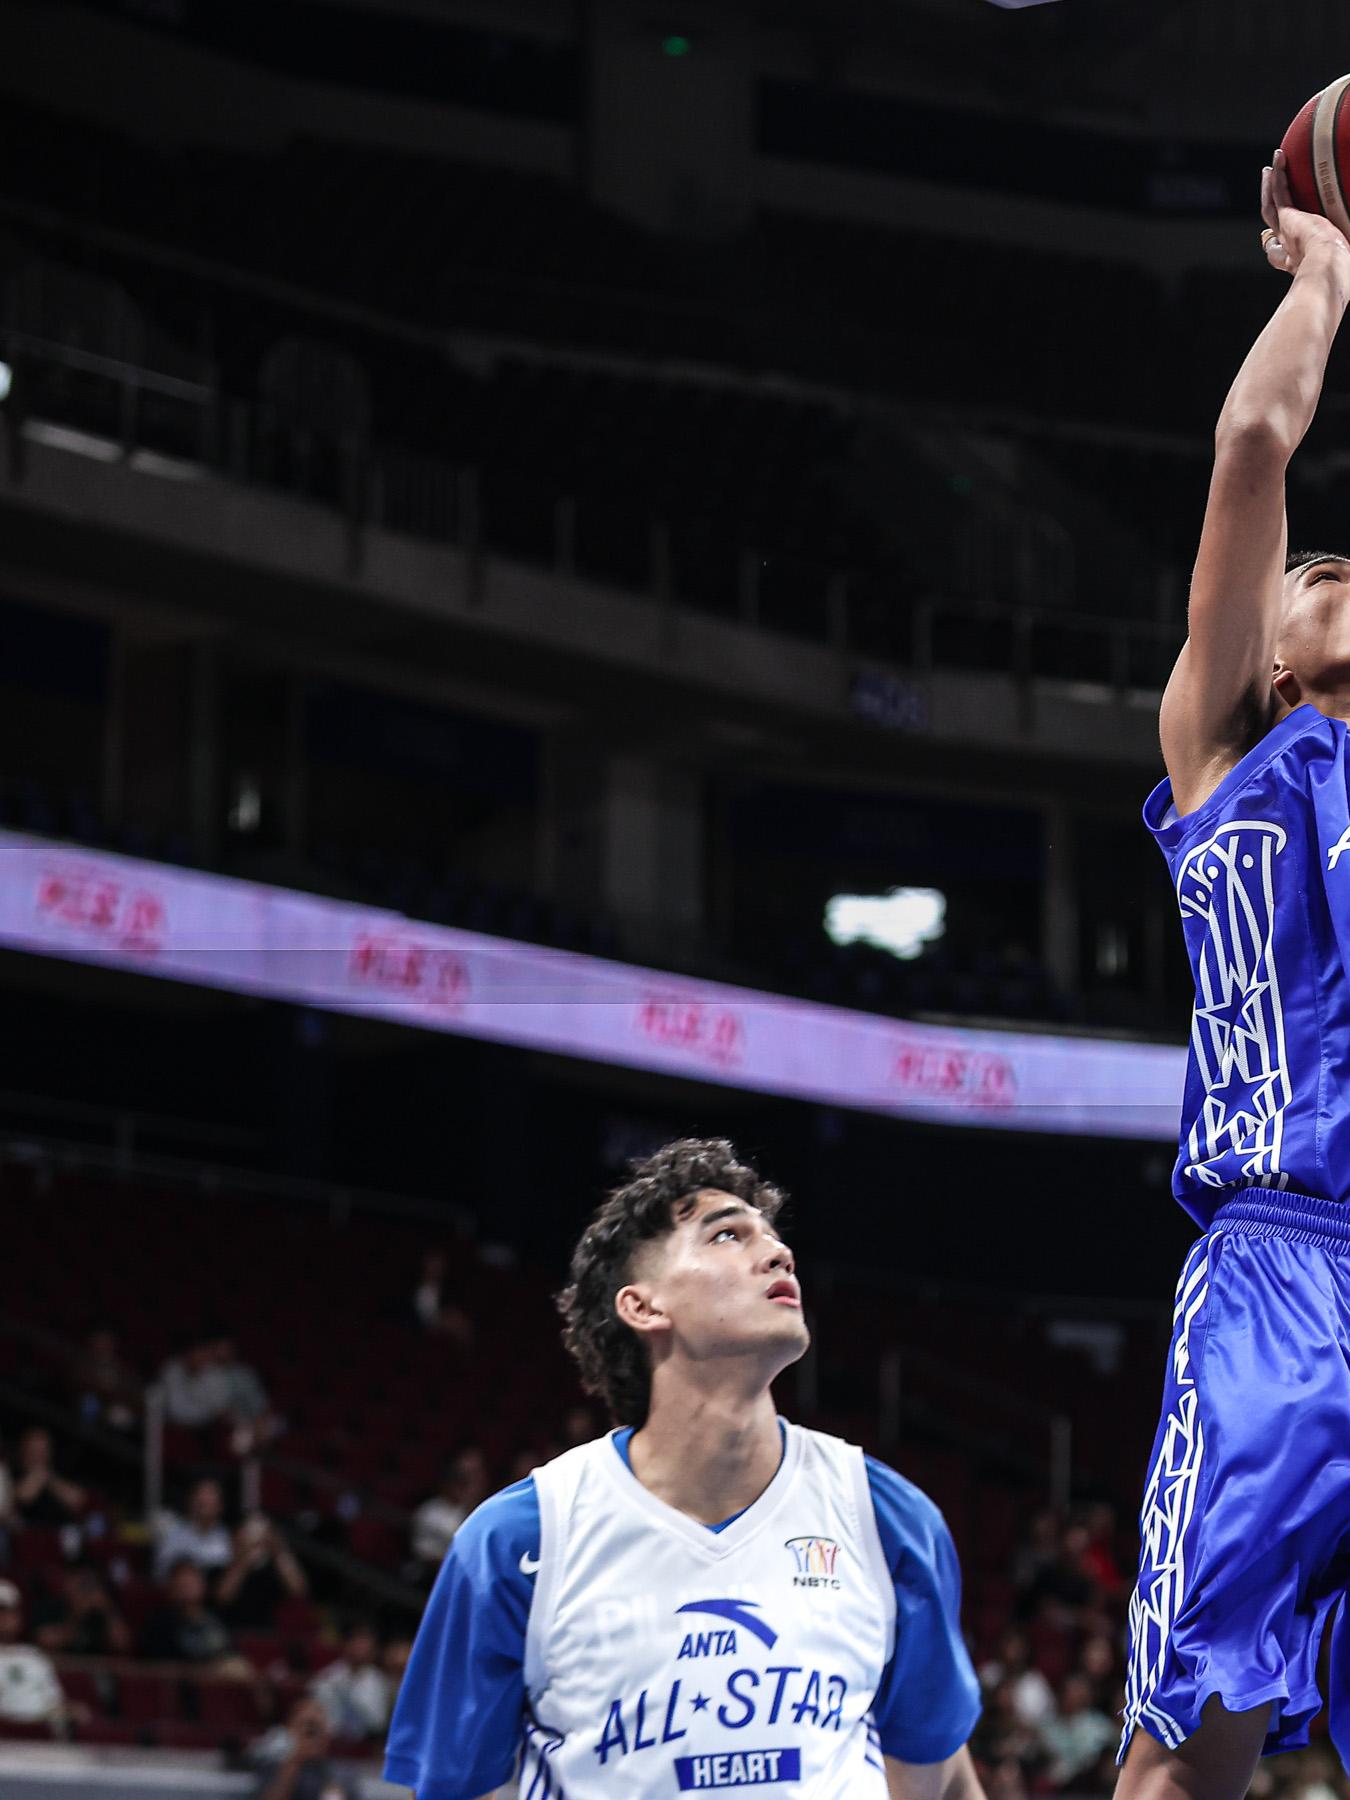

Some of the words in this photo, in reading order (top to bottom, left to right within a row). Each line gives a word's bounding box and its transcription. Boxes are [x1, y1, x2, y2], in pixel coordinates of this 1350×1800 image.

[793, 1576, 841, 1591] NBTC
[677, 1629, 738, 1660] ANTA
[594, 1679, 687, 1765] ALL
[692, 1750, 783, 1788] HEART
